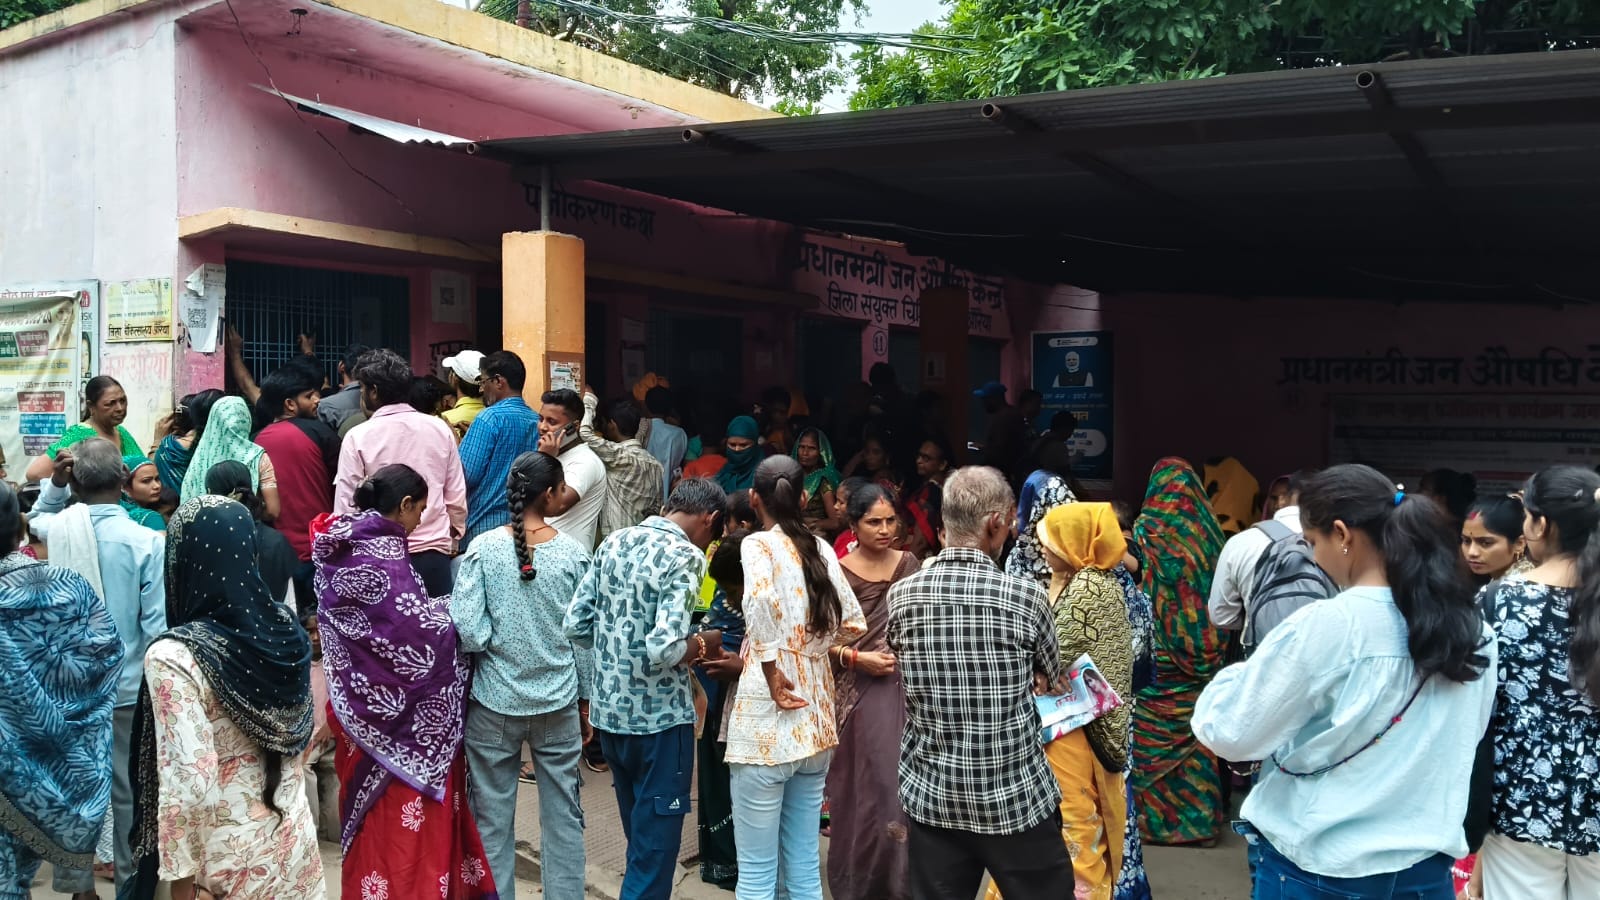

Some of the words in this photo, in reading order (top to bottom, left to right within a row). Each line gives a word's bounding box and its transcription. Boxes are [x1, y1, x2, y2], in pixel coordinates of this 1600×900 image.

[889, 260, 915, 292] जन
[827, 281, 858, 314] जिला
[861, 289, 899, 323] संयुक्त
[1276, 347, 1408, 387] प्रधानमंत्री
[1409, 356, 1465, 384] जन
